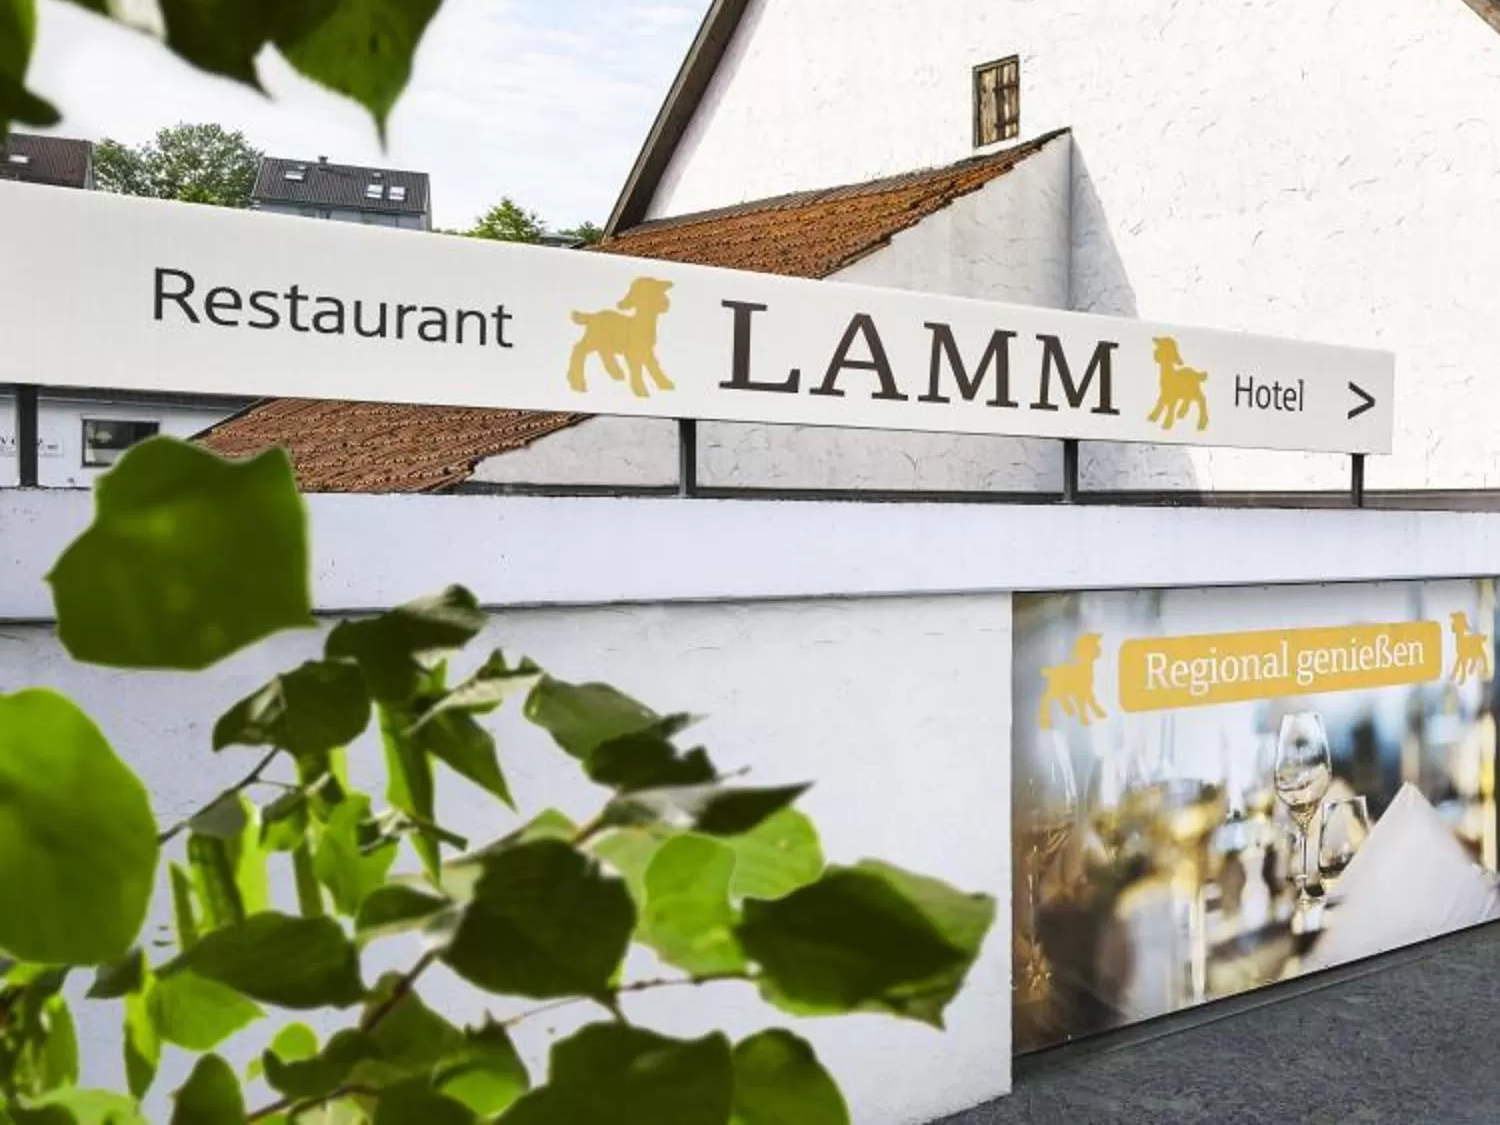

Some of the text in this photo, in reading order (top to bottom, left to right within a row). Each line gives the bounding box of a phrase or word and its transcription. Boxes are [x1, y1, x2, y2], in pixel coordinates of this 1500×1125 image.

[153, 266, 1304, 416] Restaurant LAMM Hotel
[1145, 634, 1425, 697] Regional genießen
